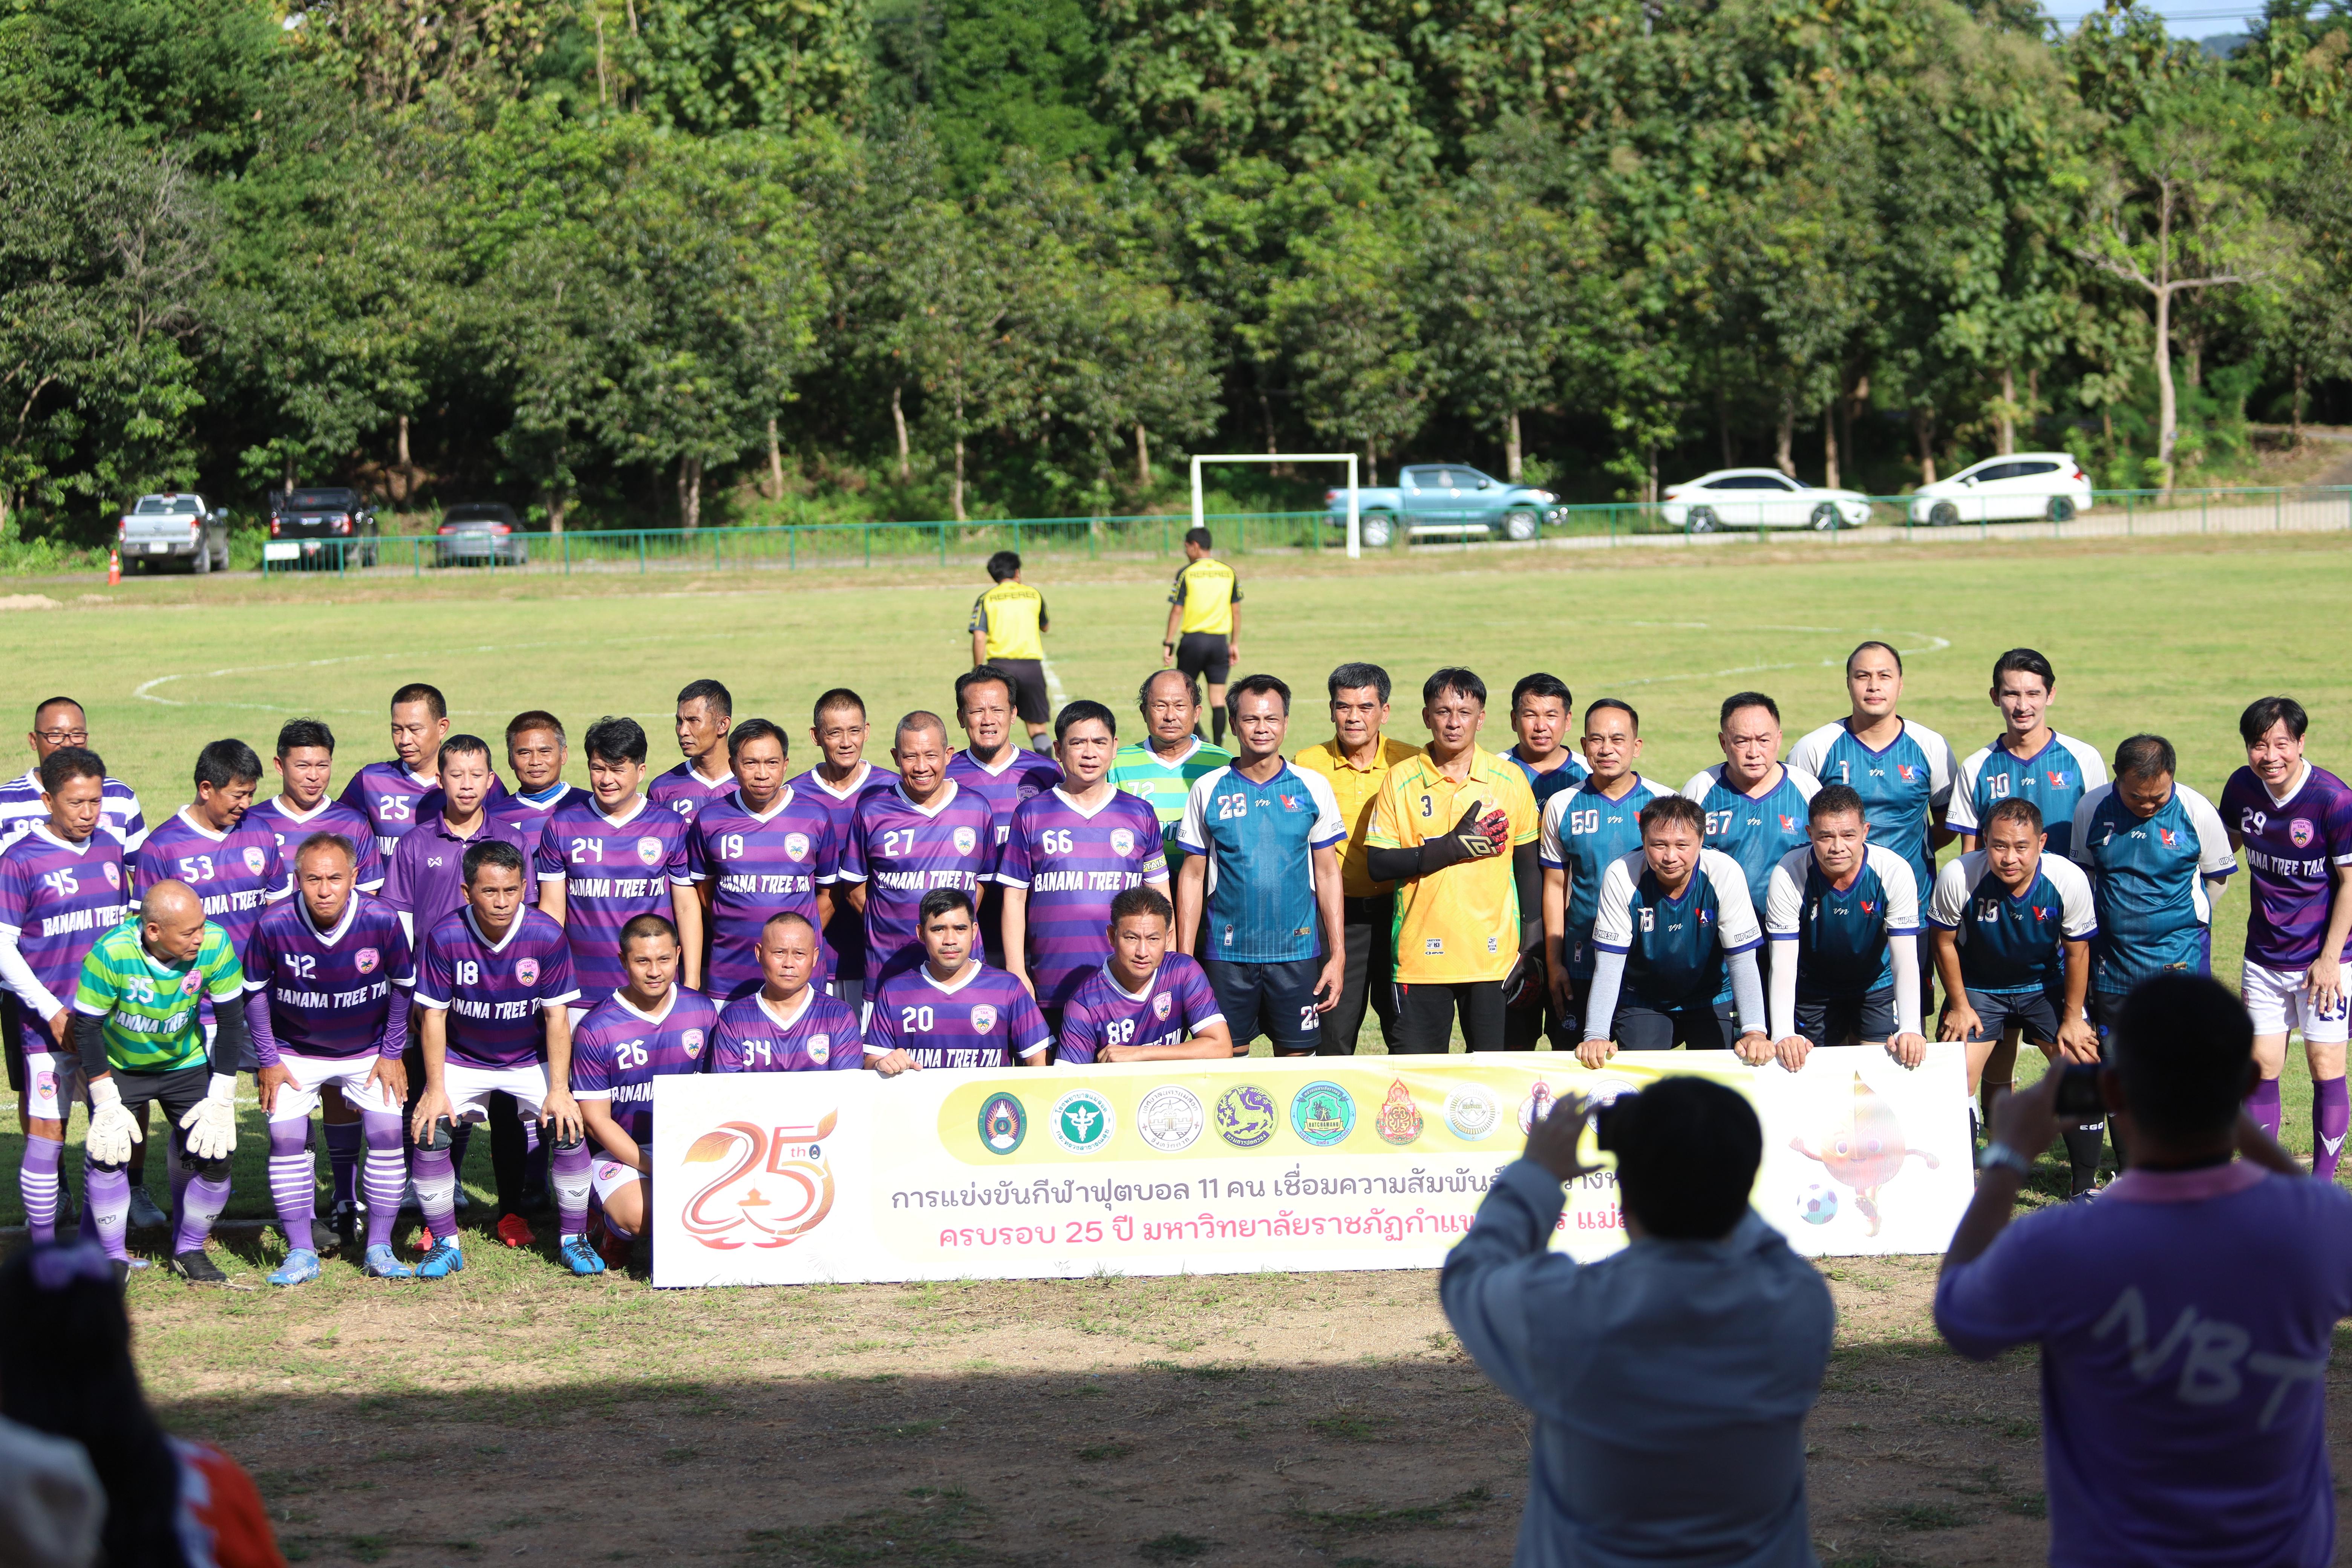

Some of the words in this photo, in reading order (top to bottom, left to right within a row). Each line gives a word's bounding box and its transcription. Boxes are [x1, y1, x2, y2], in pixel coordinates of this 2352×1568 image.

[1839, 760, 1849, 784] 1
[1127, 781, 1155, 805] 72
[1986, 772, 2010, 799] 10
[380, 795, 410, 820] 25
[1218, 793, 1247, 820] 23
[1421, 795, 1432, 816] 3
[1571, 809, 1598, 835] 50
[1706, 810, 1733, 835] 57
[2103, 822, 2115, 845] 7
[2241, 807, 2266, 836] 29
[572, 838, 603, 863] 24
[721, 834, 743, 859] 19
[884, 829, 915, 856] 27
[1042, 829, 1073, 854] 66
[179, 855, 215, 883] 53
[2271, 856, 2299, 876] TREE
[2302, 856, 2326, 876] TAK
[44, 868, 79, 897] 45
[570, 878, 610, 898] BANANA
[614, 879, 648, 899] TREE
[761, 875, 794, 894] TREE
[879, 871, 925, 890] BANANA
[929, 871, 962, 890] TREE
[1035, 871, 1083, 892] BANANA
[1088, 871, 1121, 891] TREE
[42, 909, 93, 937] BANANA
[1598, 929, 1619, 941] MAESOT
[285, 954, 317, 979] 42
[456, 960, 478, 985] 18
[277, 987, 328, 1008] BANANA
[333, 986, 368, 1008] TREE
[495, 1000, 527, 1020] TREE
[902, 1006, 934, 1033] 20
[1107, 1018, 1135, 1045] 88
[616, 1039, 648, 1070] 26
[742, 1040, 770, 1066] 34
[946, 1049, 980, 1067] TREE
[982, 1049, 1002, 1067] TAK
[1055, 1093, 1107, 1113] โรงพยาบาลแม่สอด
[1142, 1090, 1198, 1113] เทศบาลนครแม่สอด
[1056, 1129, 1110, 1150] กระทรวงสาธารณสุข
[1227, 1133, 1267, 1145] กรมการปกครอง
[681, 1116, 836, 1236] 25
[791, 1146, 806, 1158] th
[892, 1178, 1190, 1211] การแข่งขันกีฬาฟุตบอล
[1198, 1178, 1218, 1198] 11
[1227, 1180, 1265, 1197] คน
[940, 1226, 1055, 1246] ครบรอบ
[1066, 1221, 1103, 1243] 25
[1112, 1214, 1133, 1242] ปี
[2091, 1285, 2326, 1432] NBT
